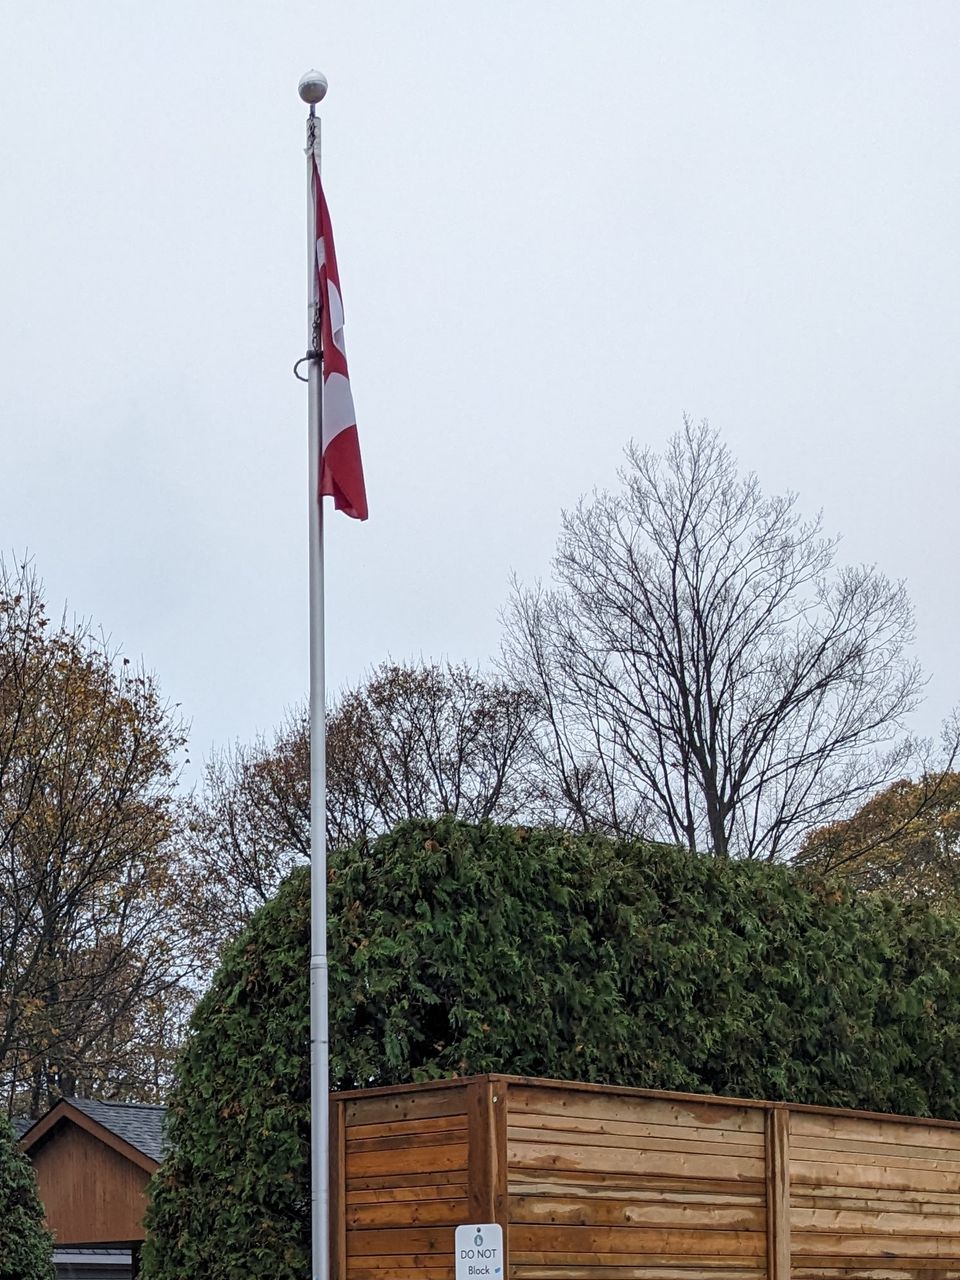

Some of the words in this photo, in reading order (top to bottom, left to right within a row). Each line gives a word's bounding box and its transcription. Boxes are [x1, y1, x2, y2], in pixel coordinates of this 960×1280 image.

[460, 1249, 475, 1260] DO
[477, 1248, 497, 1259] NOT
[468, 1265, 490, 1275] Block
